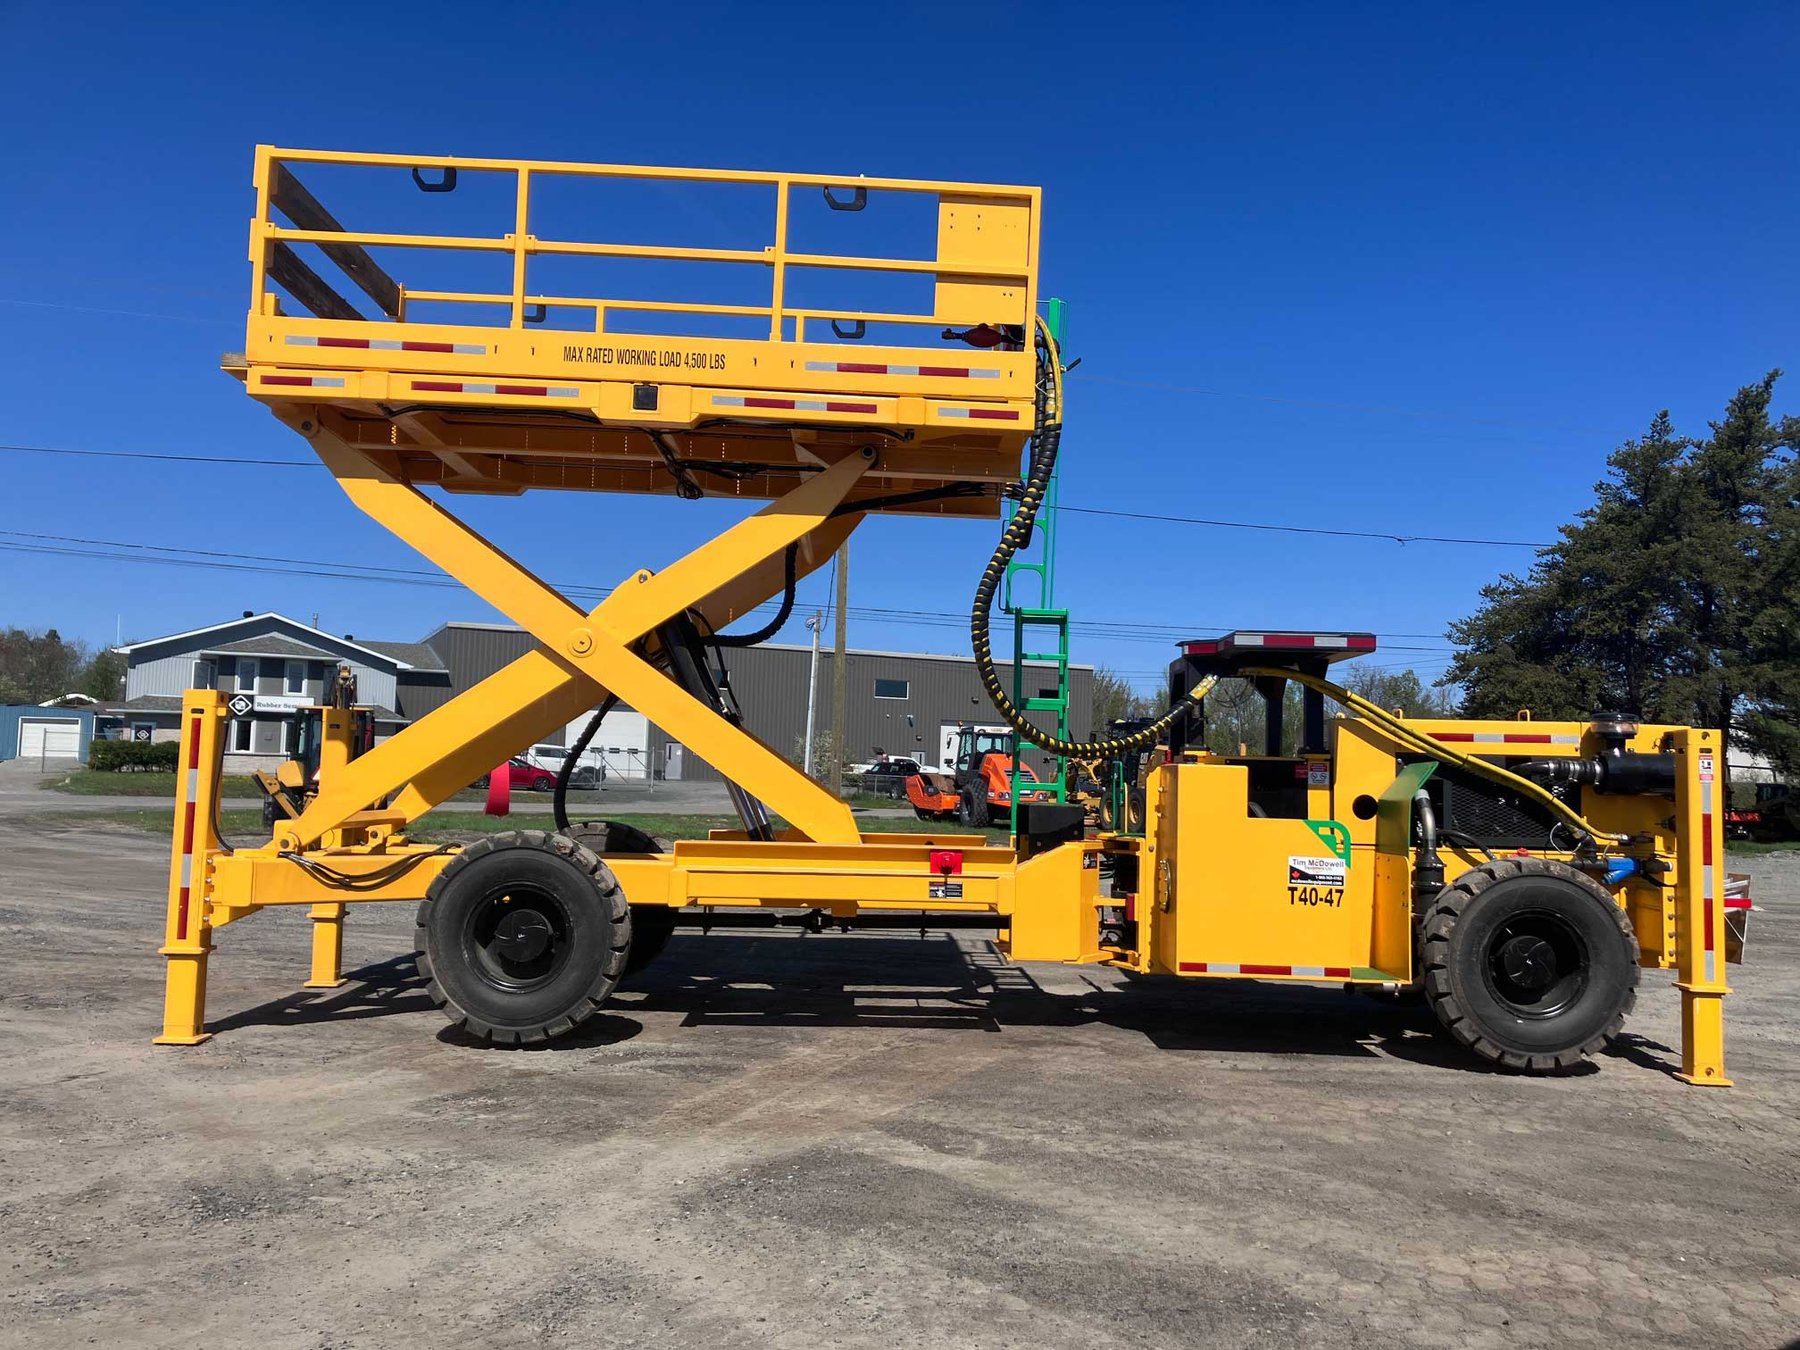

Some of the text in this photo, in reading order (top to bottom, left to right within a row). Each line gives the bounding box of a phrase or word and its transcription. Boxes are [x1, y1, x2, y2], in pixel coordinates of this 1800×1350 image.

[563, 346, 726, 371] MAX RATED WORKING LOAD 4,500 LBS
[256, 701, 281, 709] Rubber
[1292, 858, 1344, 868] Tim McDowell
[1287, 886, 1345, 908] T40-47
